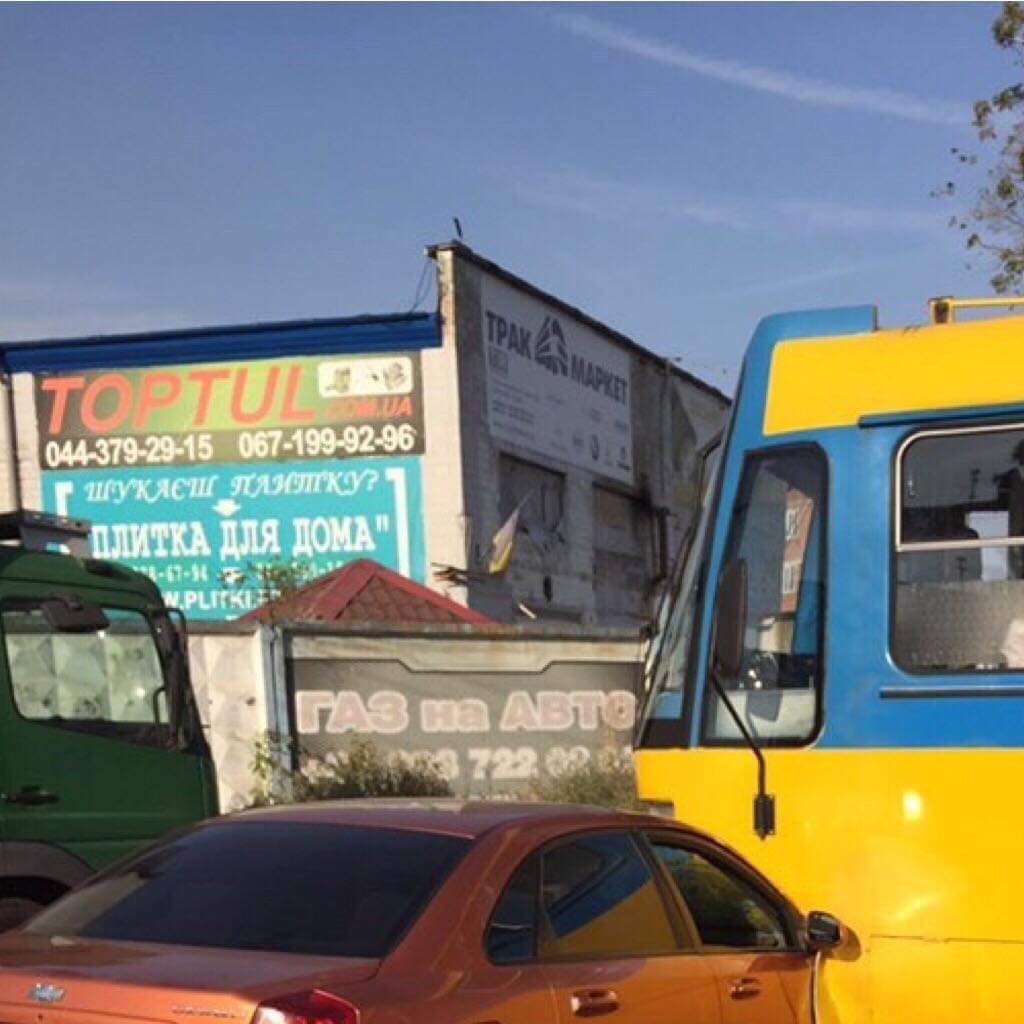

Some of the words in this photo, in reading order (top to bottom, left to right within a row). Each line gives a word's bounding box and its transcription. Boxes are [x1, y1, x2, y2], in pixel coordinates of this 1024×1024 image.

[485, 310, 532, 360] ТРАК
[570, 352, 628, 405] МАРКЕТ
[41, 365, 315, 435] TOPTUL
[46, 434, 213, 468] 044-379-29-15
[239, 423, 416, 458] 067-199-92-96
[220, 519, 281, 561] ДЛЯ
[293, 512, 390, 557] ДОМА"
[296, 690, 409, 734] ГАЗ
[420, 698, 491, 733] на
[501, 690, 637, 732] АВТО
[468, 746, 539, 779] 722
